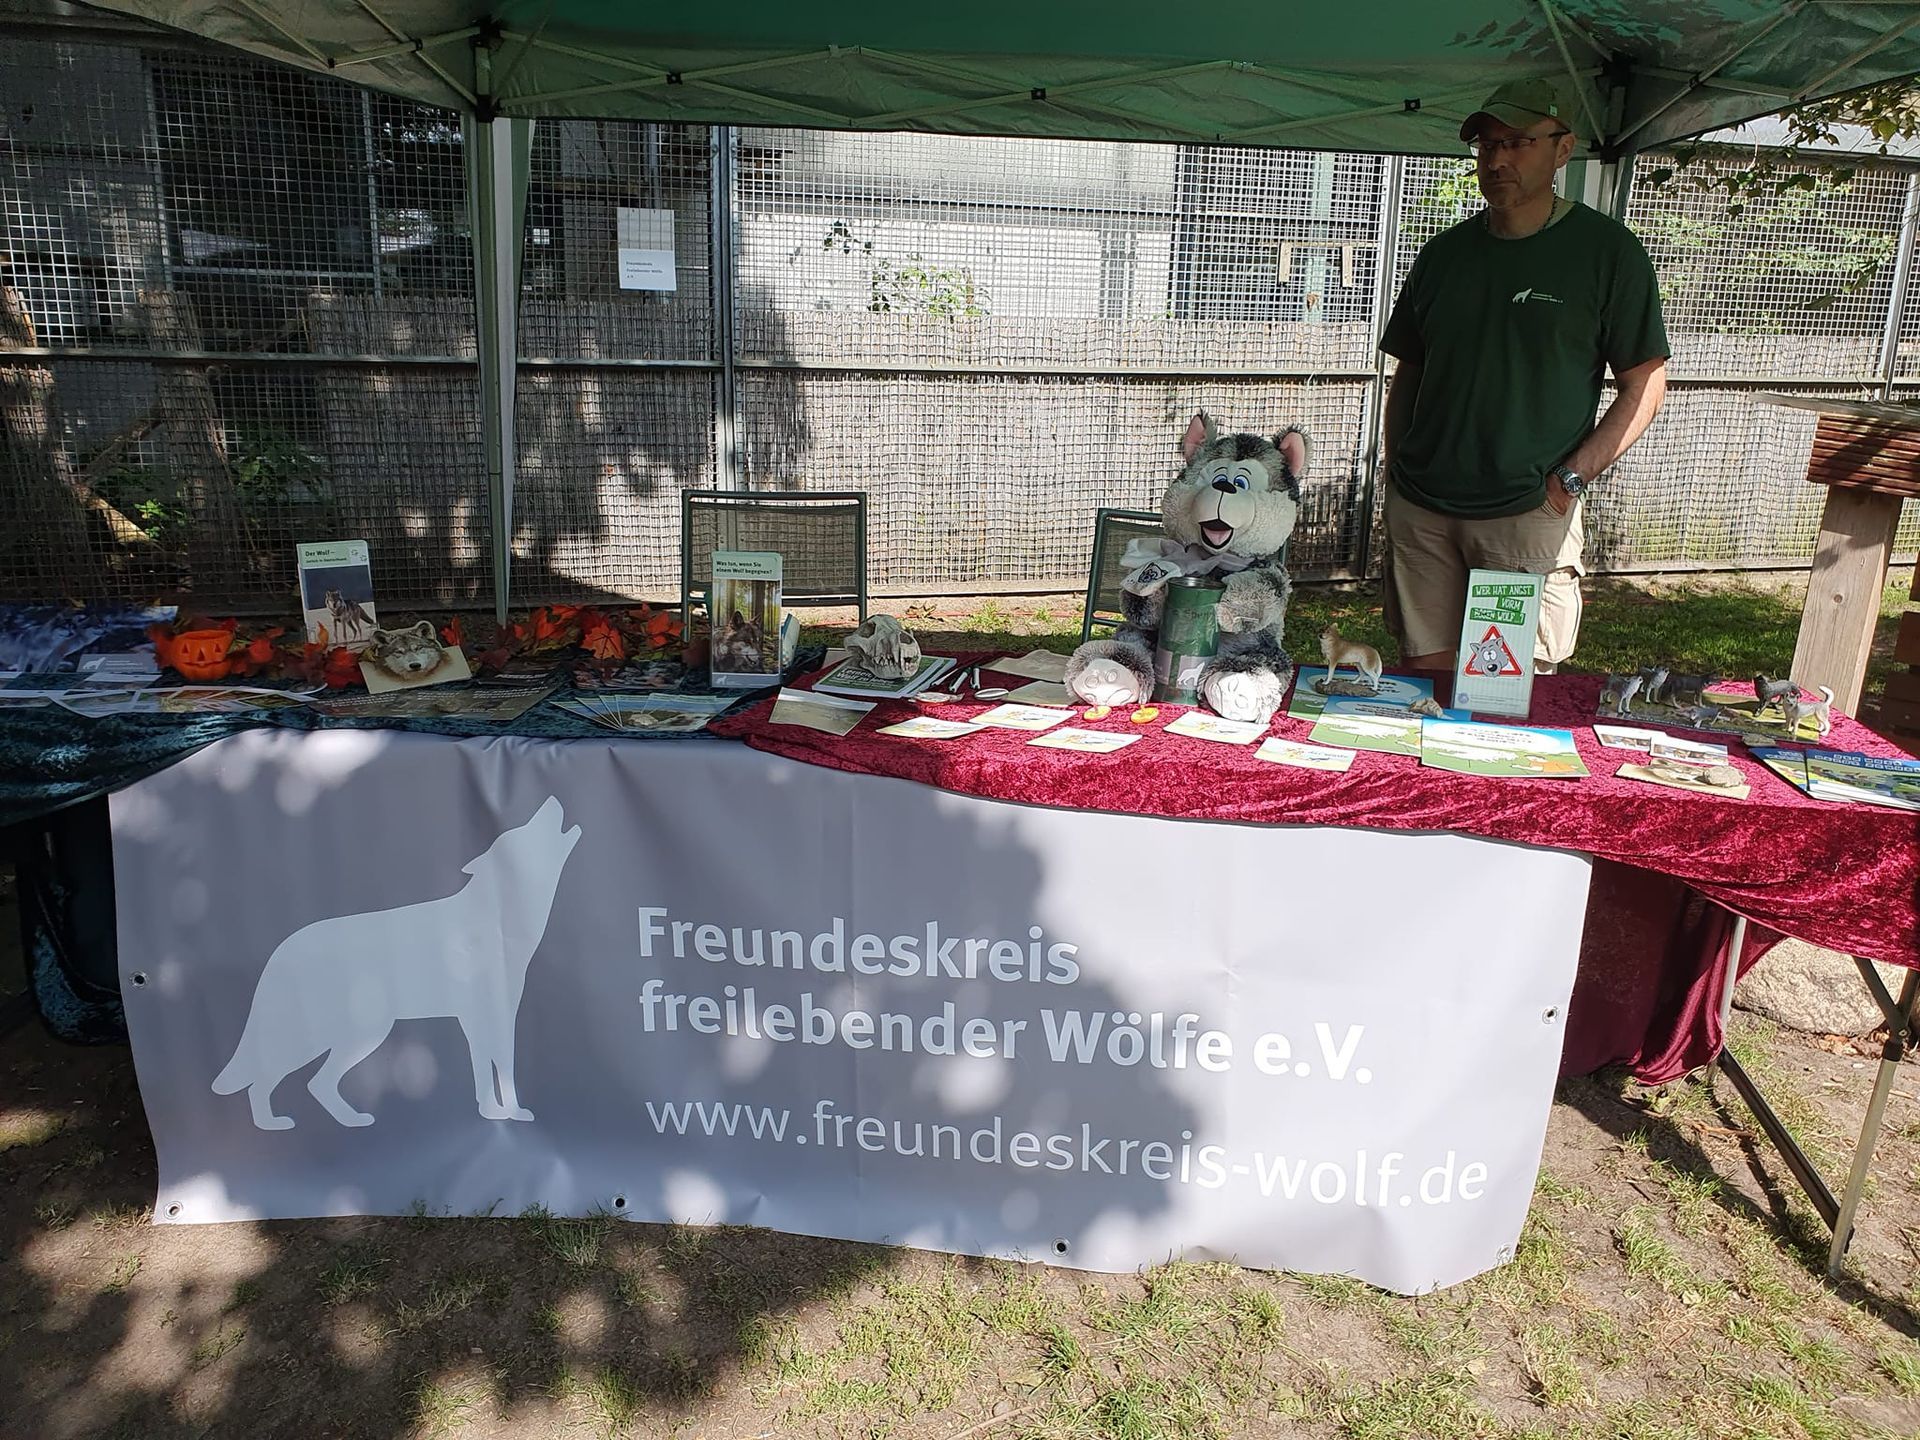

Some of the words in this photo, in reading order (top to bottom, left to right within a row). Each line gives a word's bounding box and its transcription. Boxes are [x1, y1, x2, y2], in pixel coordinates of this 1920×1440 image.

[745, 568, 773, 576] begegnen?
[1474, 585, 1491, 596] WER
[1492, 586, 1508, 596] HAT
[1508, 585, 1533, 597] ANGST
[1502, 598, 1522, 610] VORM
[1497, 611, 1516, 622] WOLF
[637, 906, 1081, 985] Freundeskreis
[639, 979, 1028, 1060] freilebender
[1040, 1008, 1233, 1073] Wölfe
[1252, 1021, 1374, 1085] e.V.
[645, 1099, 1489, 1208] www.freundeskreis-wolf.de
